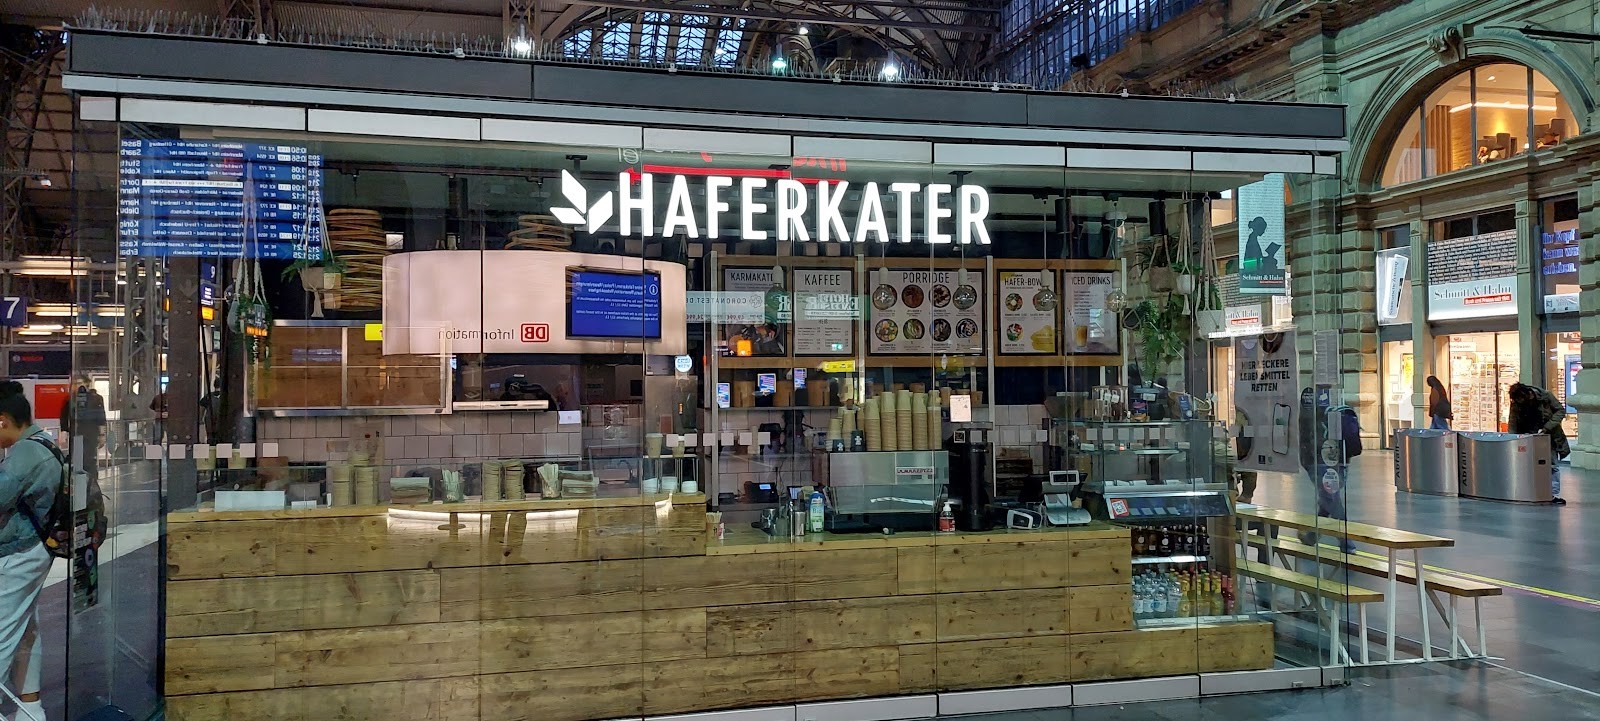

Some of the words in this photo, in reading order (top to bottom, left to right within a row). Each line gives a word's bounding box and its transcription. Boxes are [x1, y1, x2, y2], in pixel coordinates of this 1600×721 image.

[618, 171, 992, 245] HAFERKATER
[804, 274, 841, 285] KAFFEE
[903, 272, 950, 283] PORRIDGE
[1072, 277, 1086, 285] ICED
[1087, 277, 1110, 285] DRINKS
[1434, 286, 1470, 300] Schmitt
[1473, 286, 1480, 296] &
[1484, 284, 1511, 295] Hahn
[4, 296, 20, 318] 7
[1258, 358, 1290, 368] ECKERE
[1251, 383, 1278, 392] RETTEN
